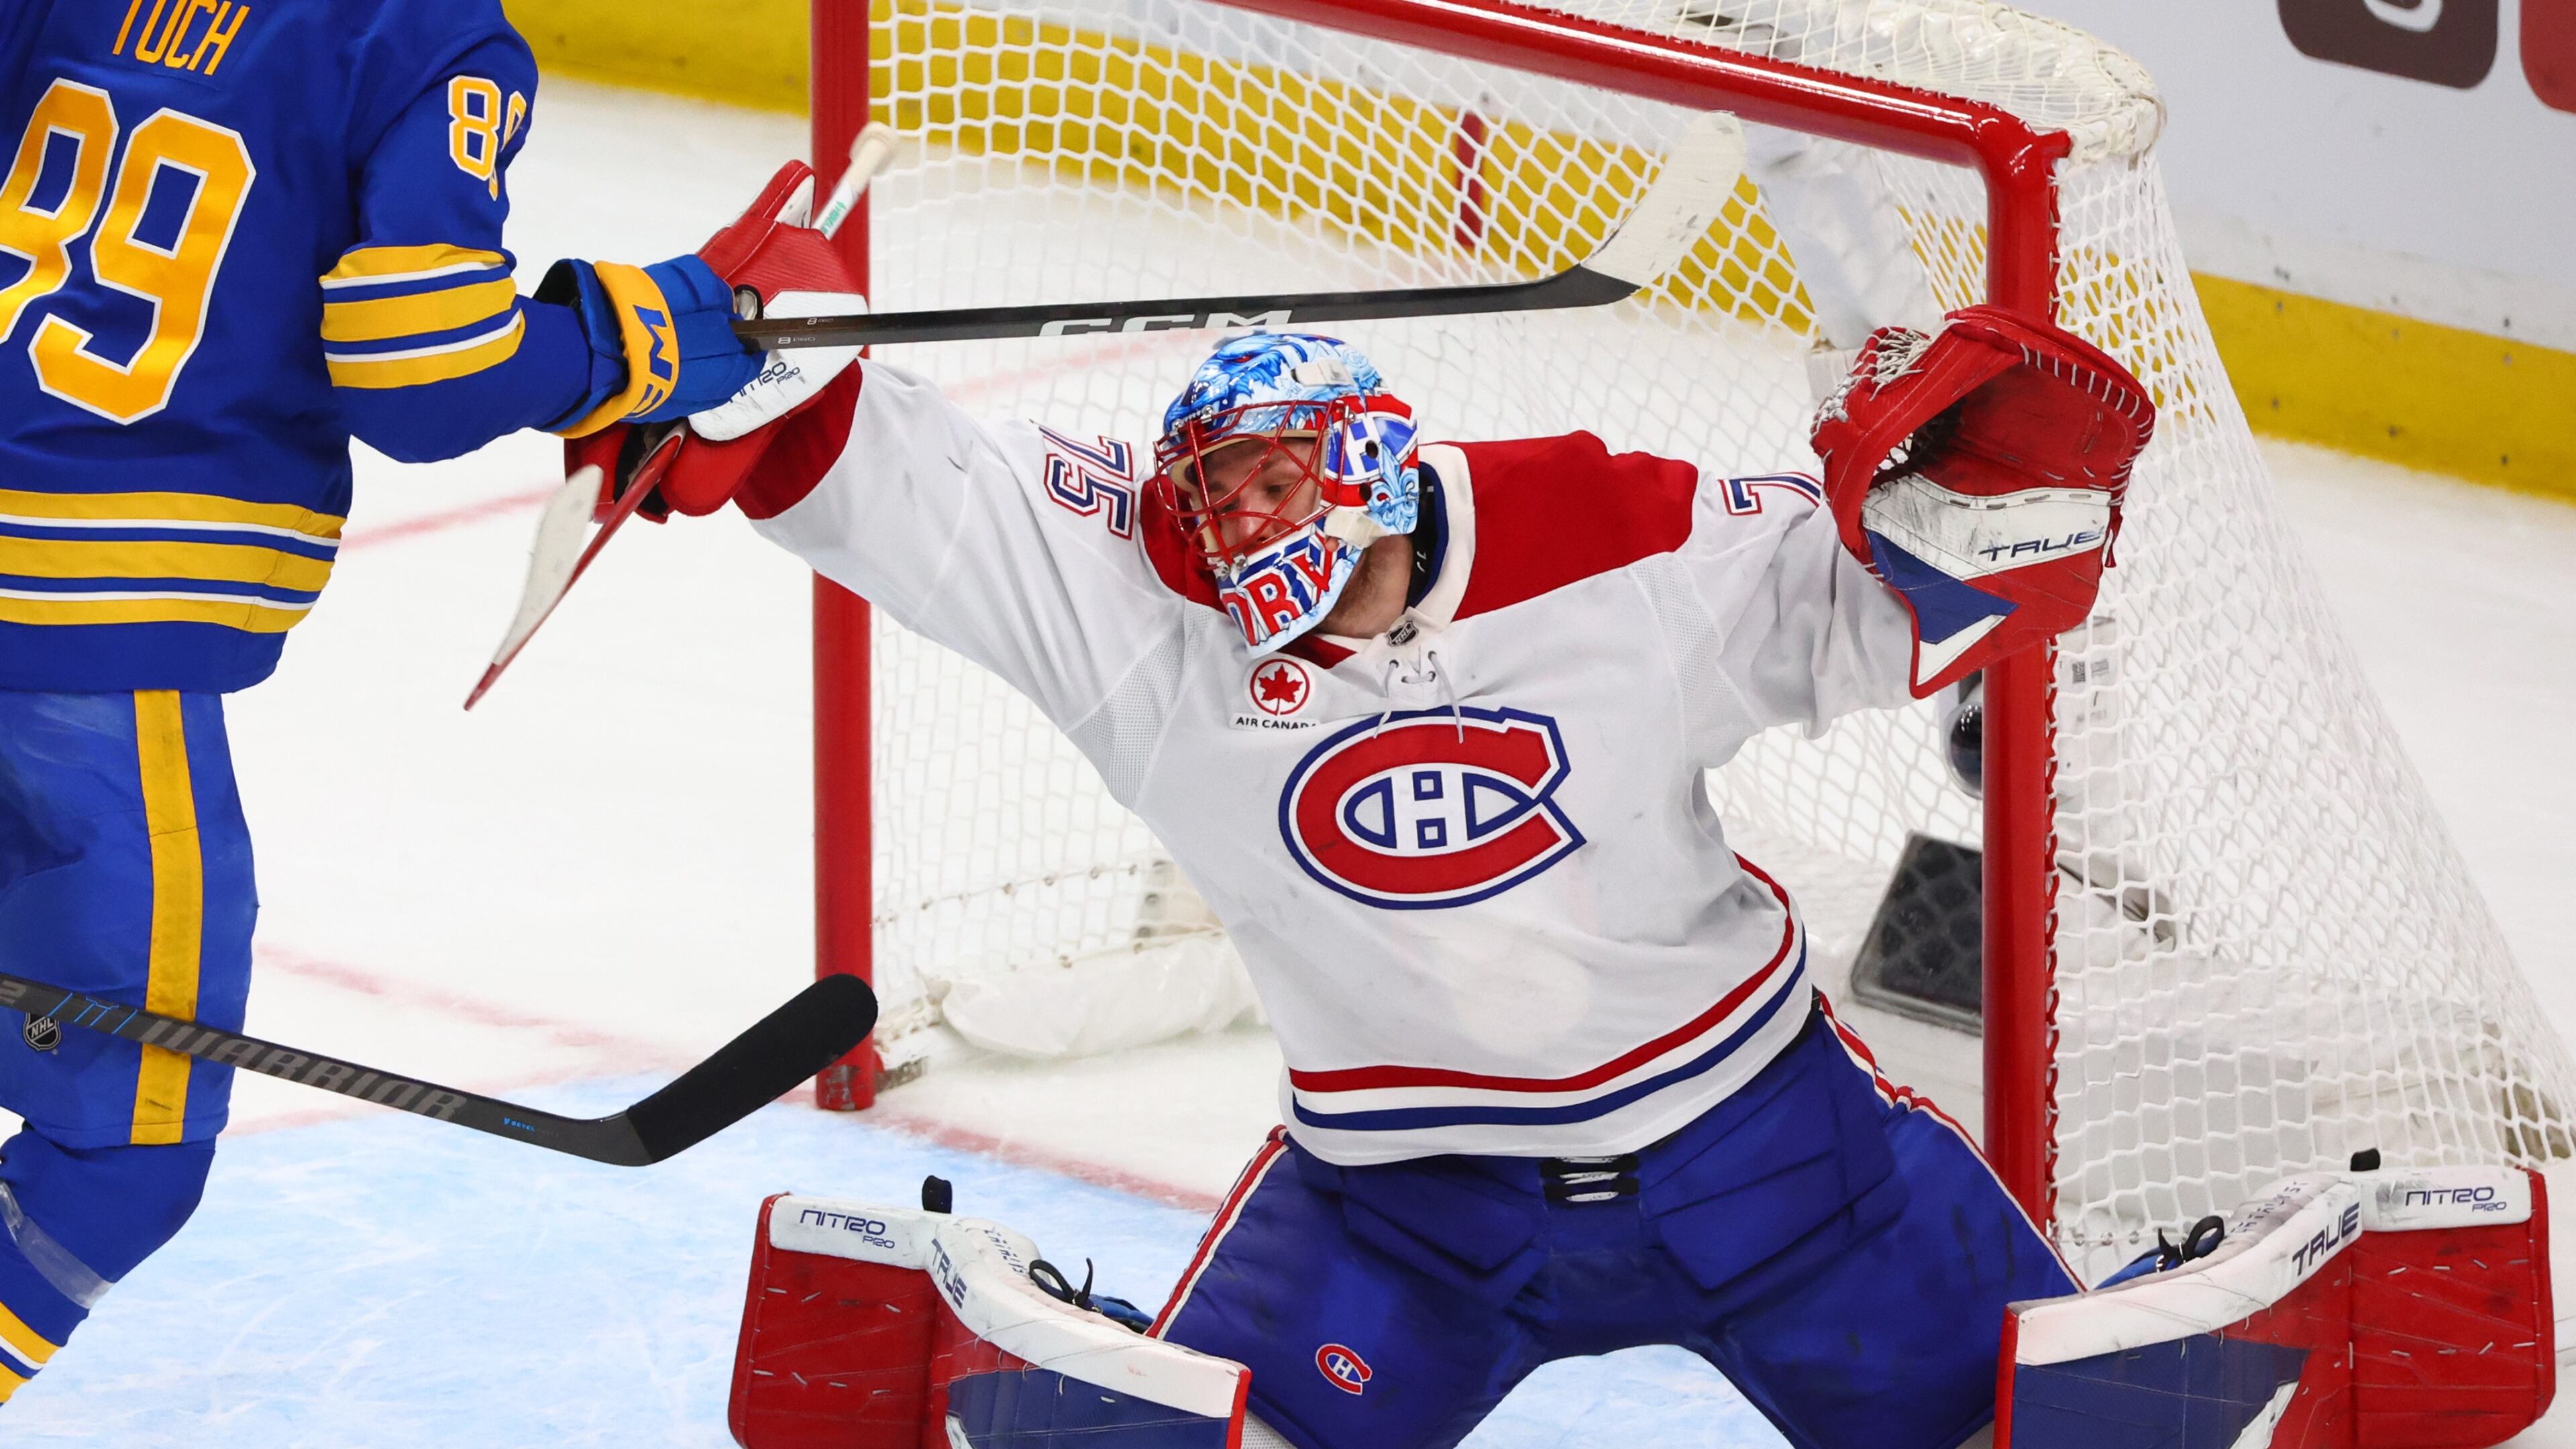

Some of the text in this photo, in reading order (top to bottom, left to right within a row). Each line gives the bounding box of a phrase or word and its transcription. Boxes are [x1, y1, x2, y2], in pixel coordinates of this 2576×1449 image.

[1037, 424, 1136, 541] 75
[1978, 530, 2102, 561] TRUE
[1236, 716, 1316, 730] AIR CANAD
[31, 1017, 55, 1038] NHL
[138, 1020, 468, 1120] WARRIOR
[2406, 1186, 2495, 1206] NITRO
[2472, 1201, 2507, 1213] PRO
[799, 1210, 886, 1236] NITRO
[862, 1234, 896, 1249] PRO
[2292, 1201, 2360, 1277] TRUE
[930, 1238, 968, 1310] TRUE
